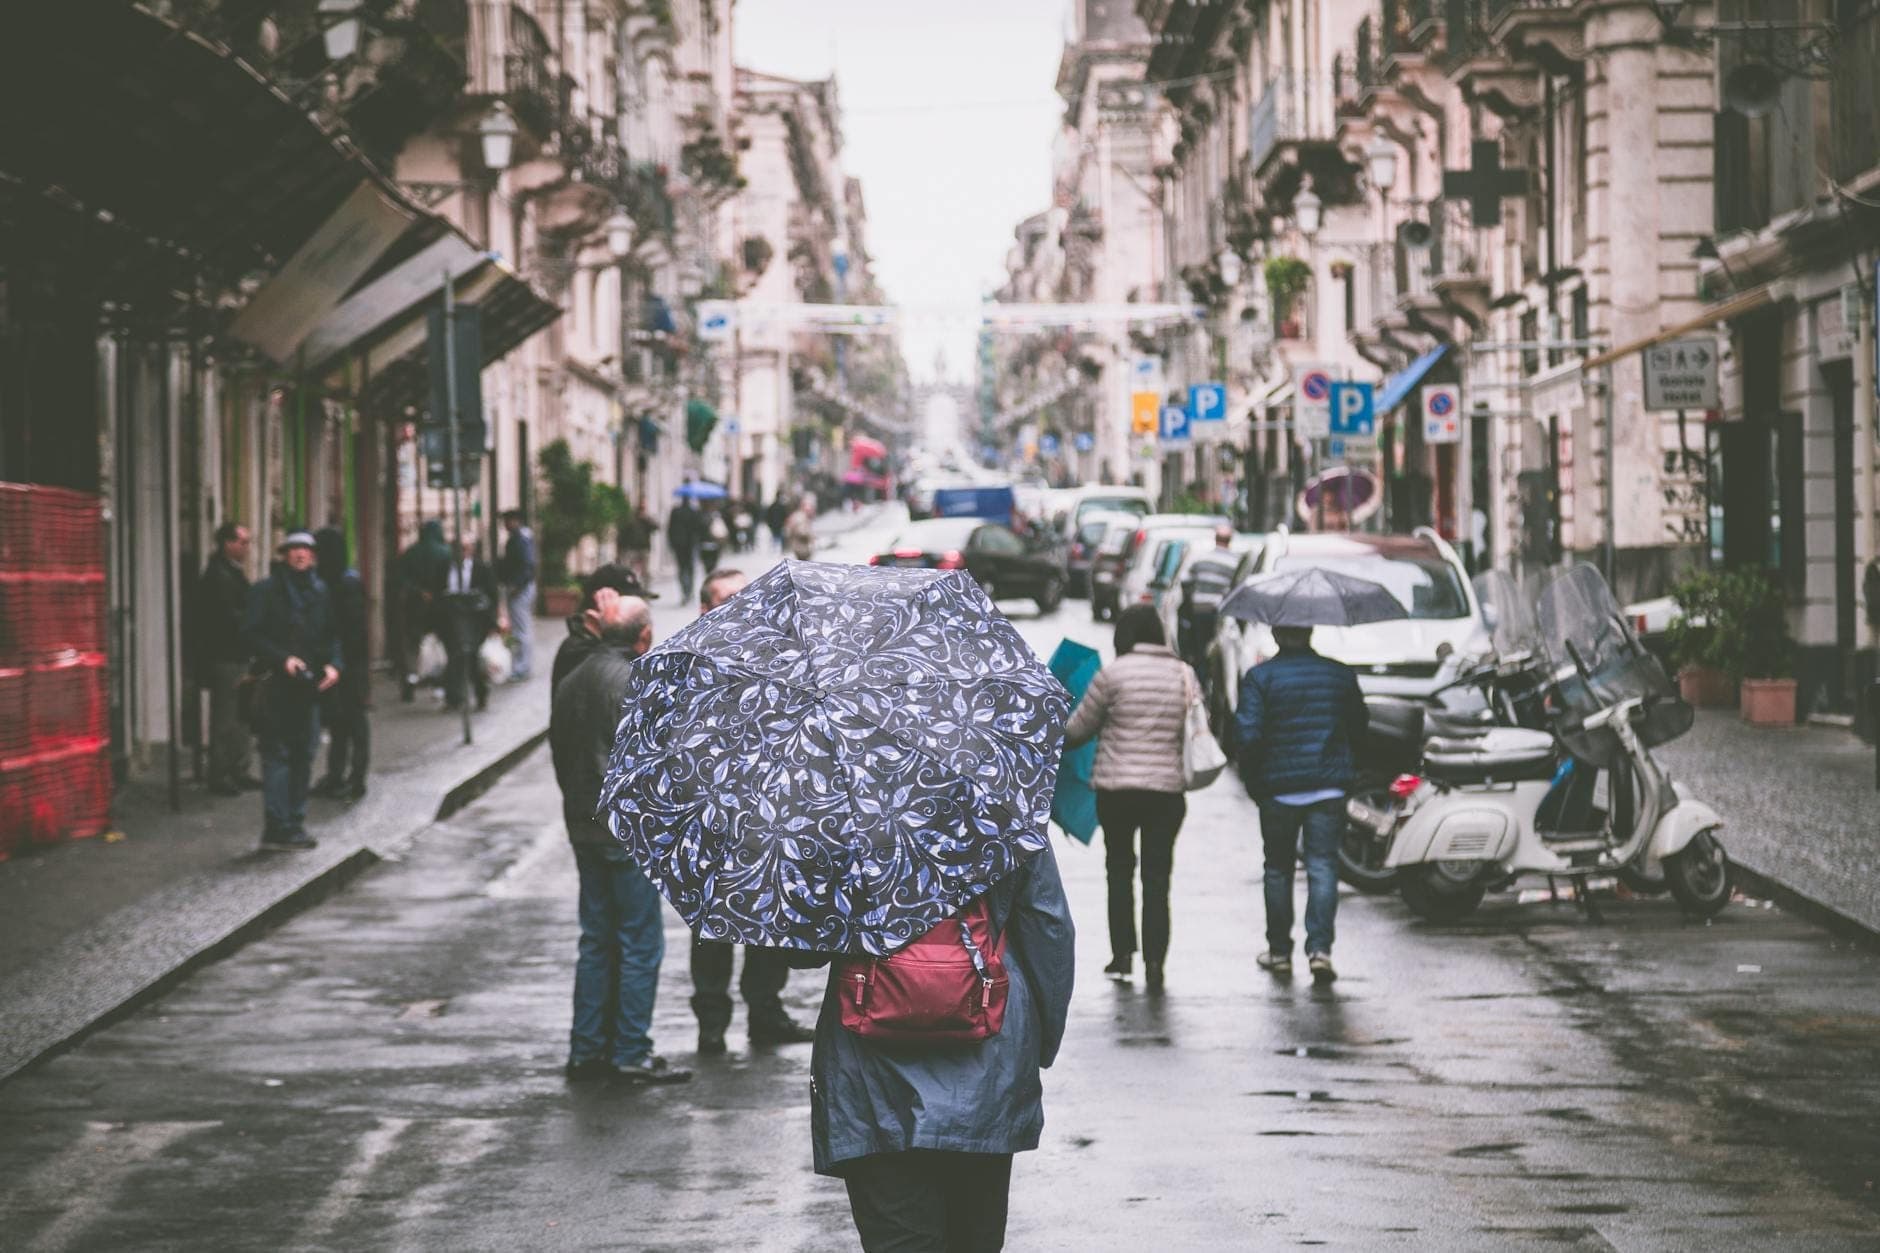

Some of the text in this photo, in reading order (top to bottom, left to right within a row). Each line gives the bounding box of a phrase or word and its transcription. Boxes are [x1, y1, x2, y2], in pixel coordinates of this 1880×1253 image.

[1196, 387, 1219, 418] P
[1340, 388, 1364, 426] P
[1163, 407, 1186, 435] P
